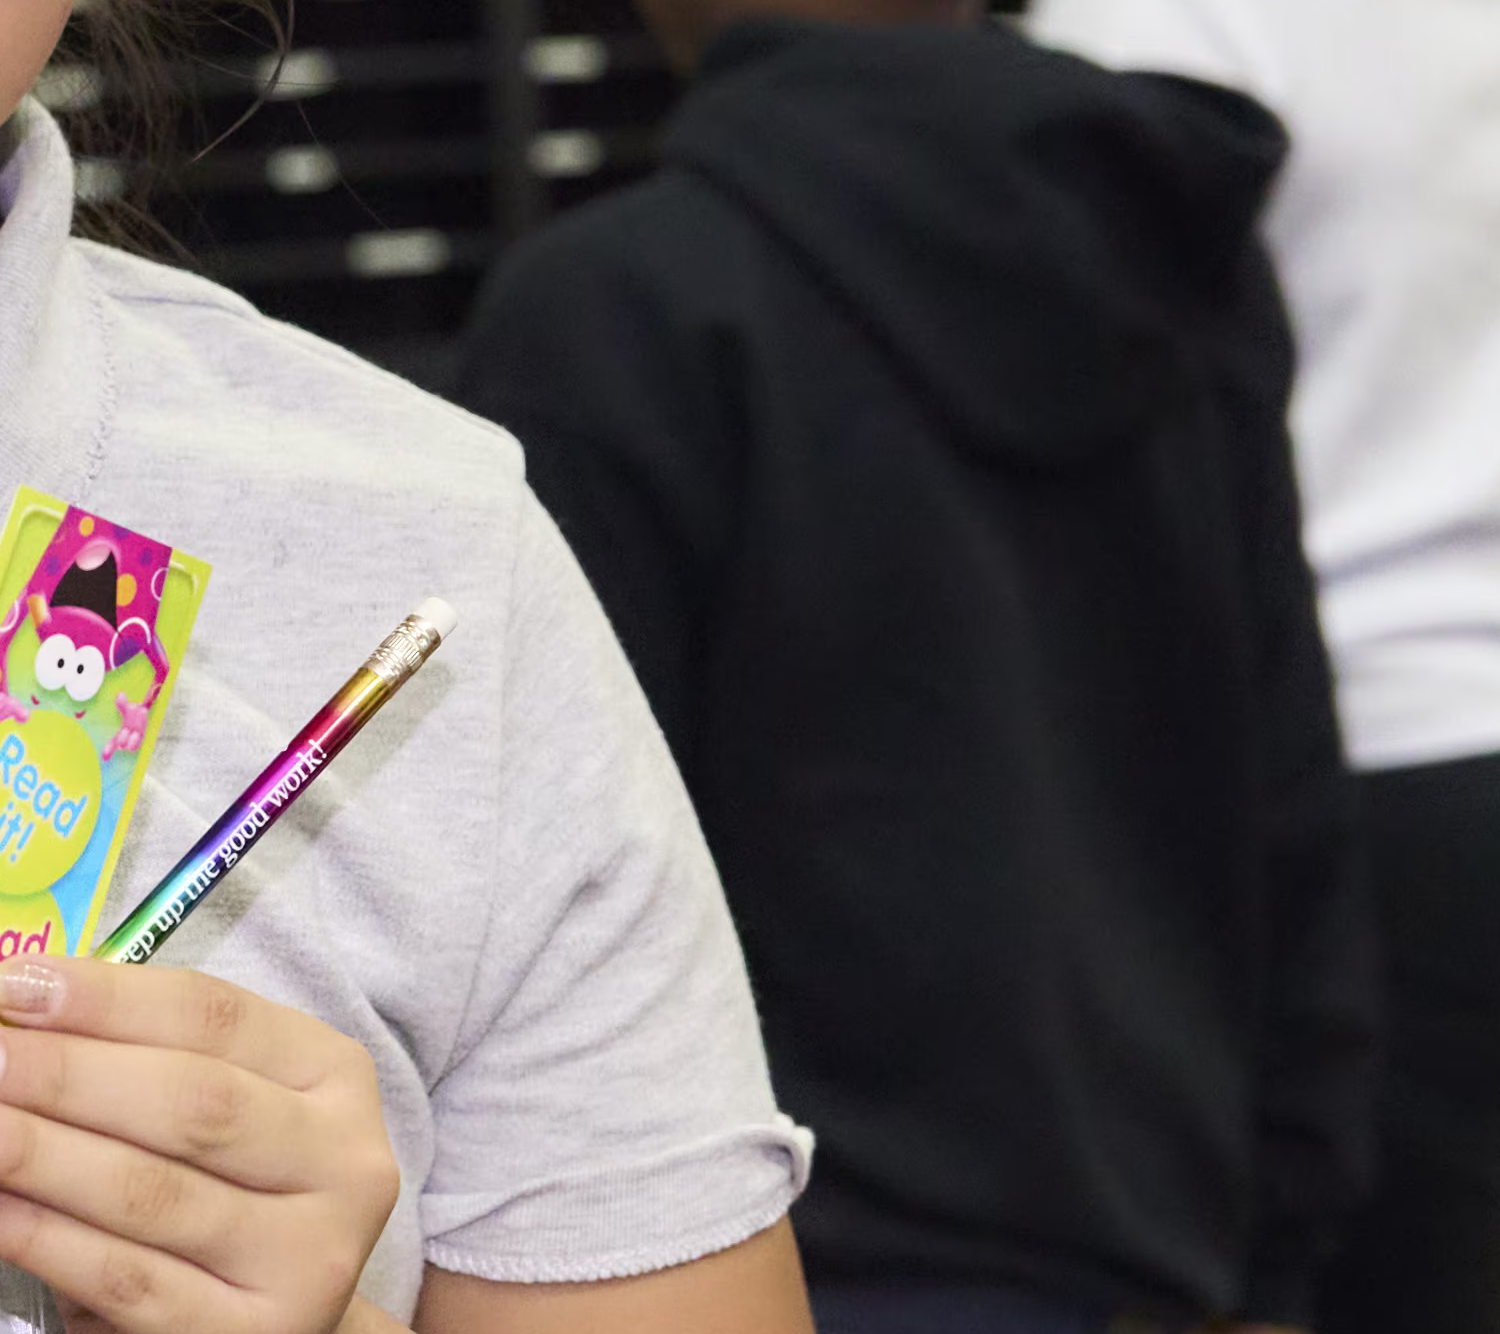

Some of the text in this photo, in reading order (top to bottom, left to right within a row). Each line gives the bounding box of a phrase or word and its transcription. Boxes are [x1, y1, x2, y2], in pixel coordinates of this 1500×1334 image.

[155, 897, 185, 932] up
[218, 801, 270, 868] good
[264, 738, 328, 807] work!
